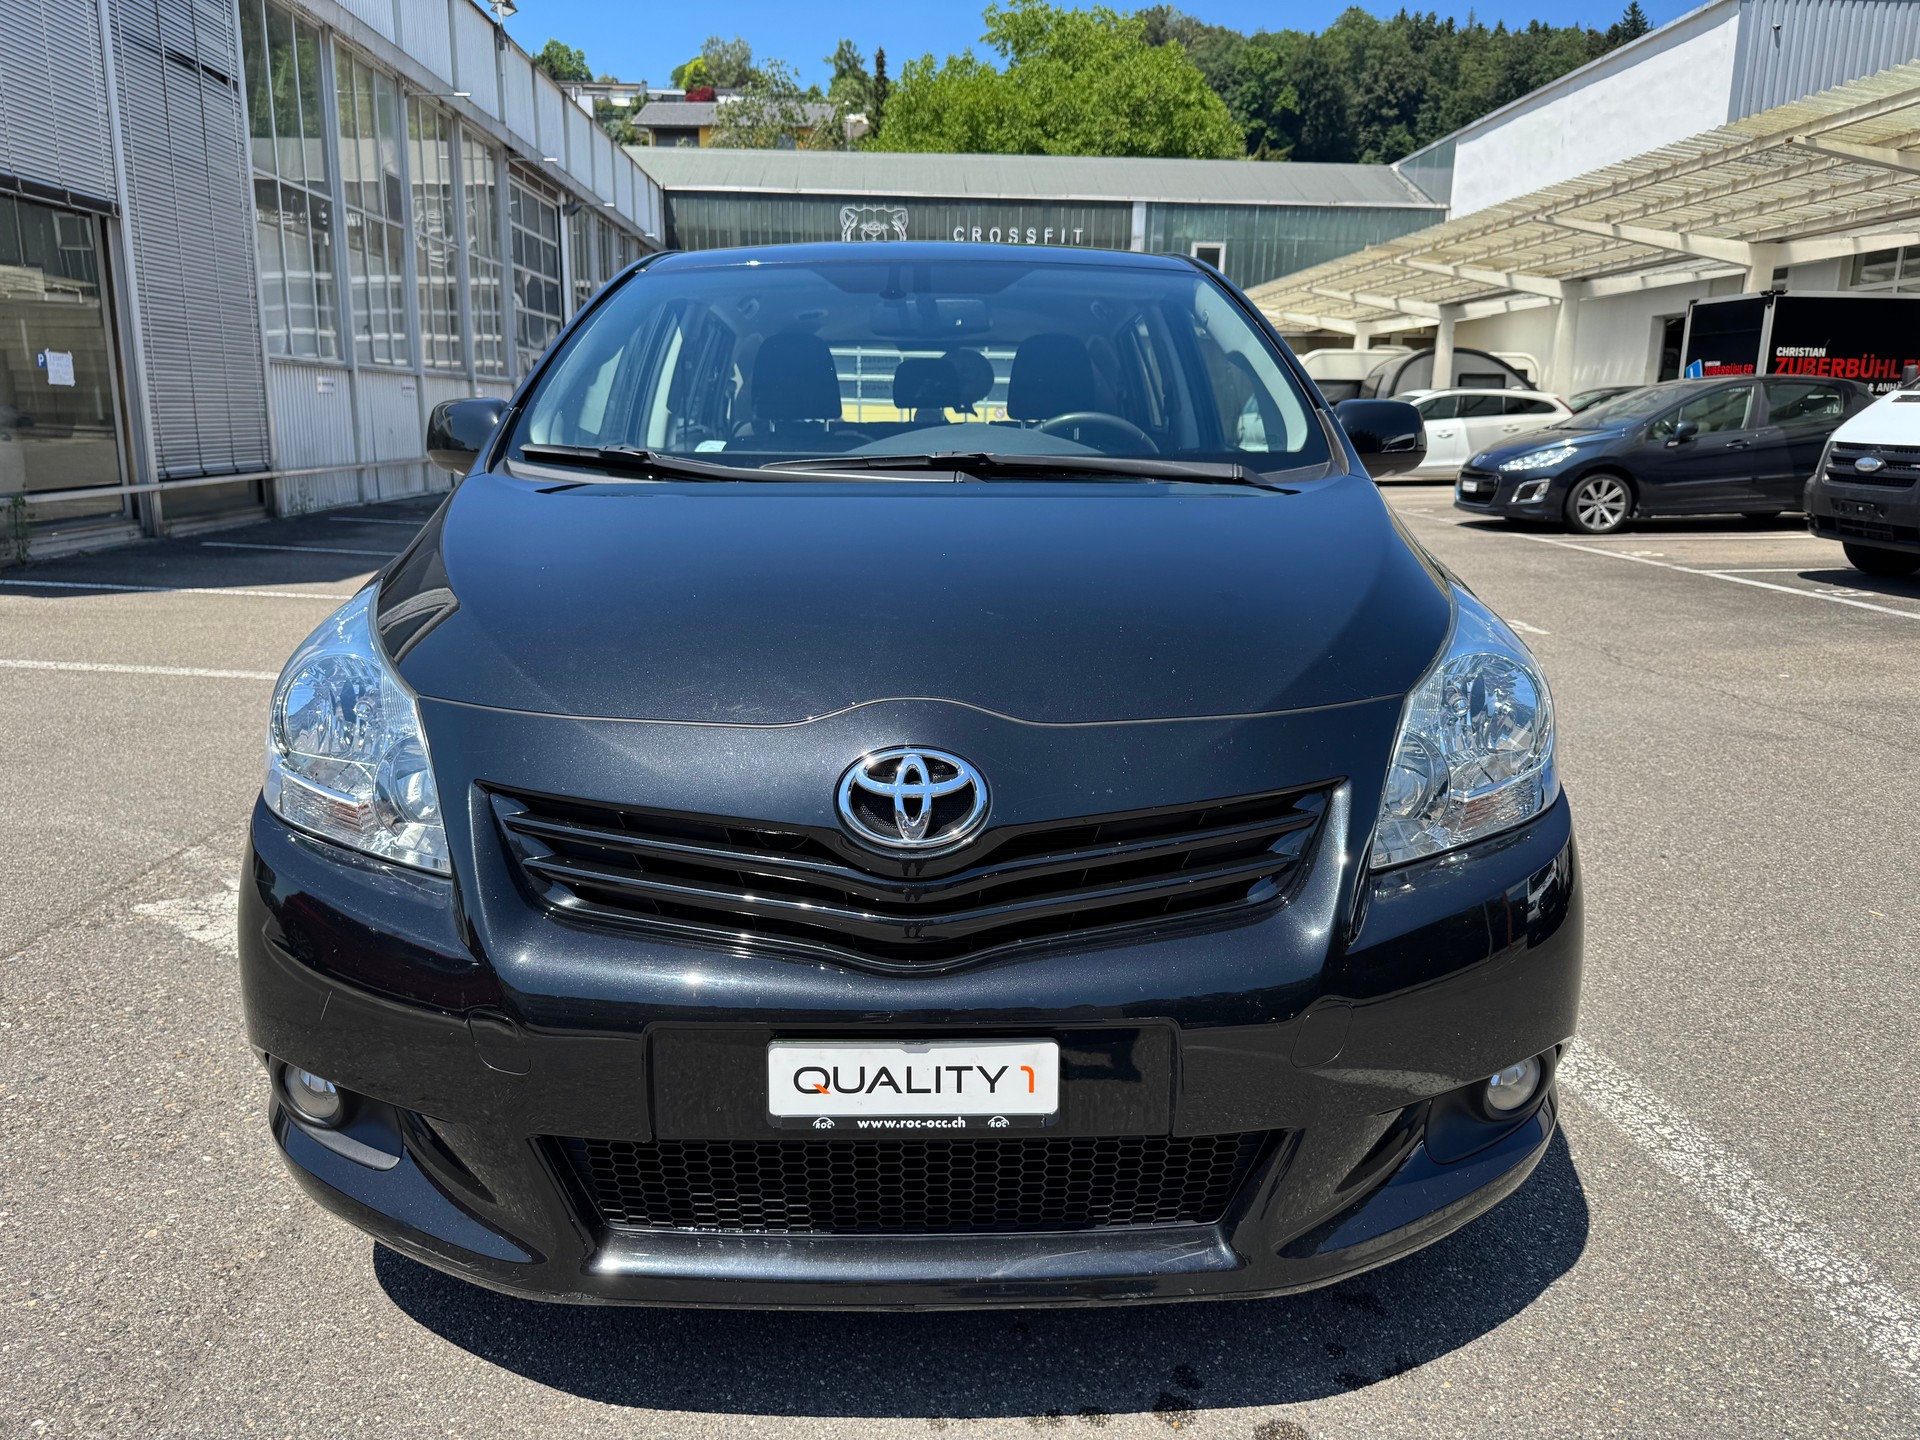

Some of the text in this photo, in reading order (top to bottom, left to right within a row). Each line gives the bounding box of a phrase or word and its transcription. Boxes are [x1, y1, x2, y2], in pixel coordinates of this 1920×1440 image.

[953, 225, 1083, 244] CROSSFIT
[1776, 347, 1826, 357] CHRISTIAN
[37, 353, 45, 367] P
[1775, 353, 1920, 379] ZUBERBÜHL
[1867, 382, 1875, 392] &
[815, 1116, 1008, 1129] ROC www.roc-occ.ch ROC
